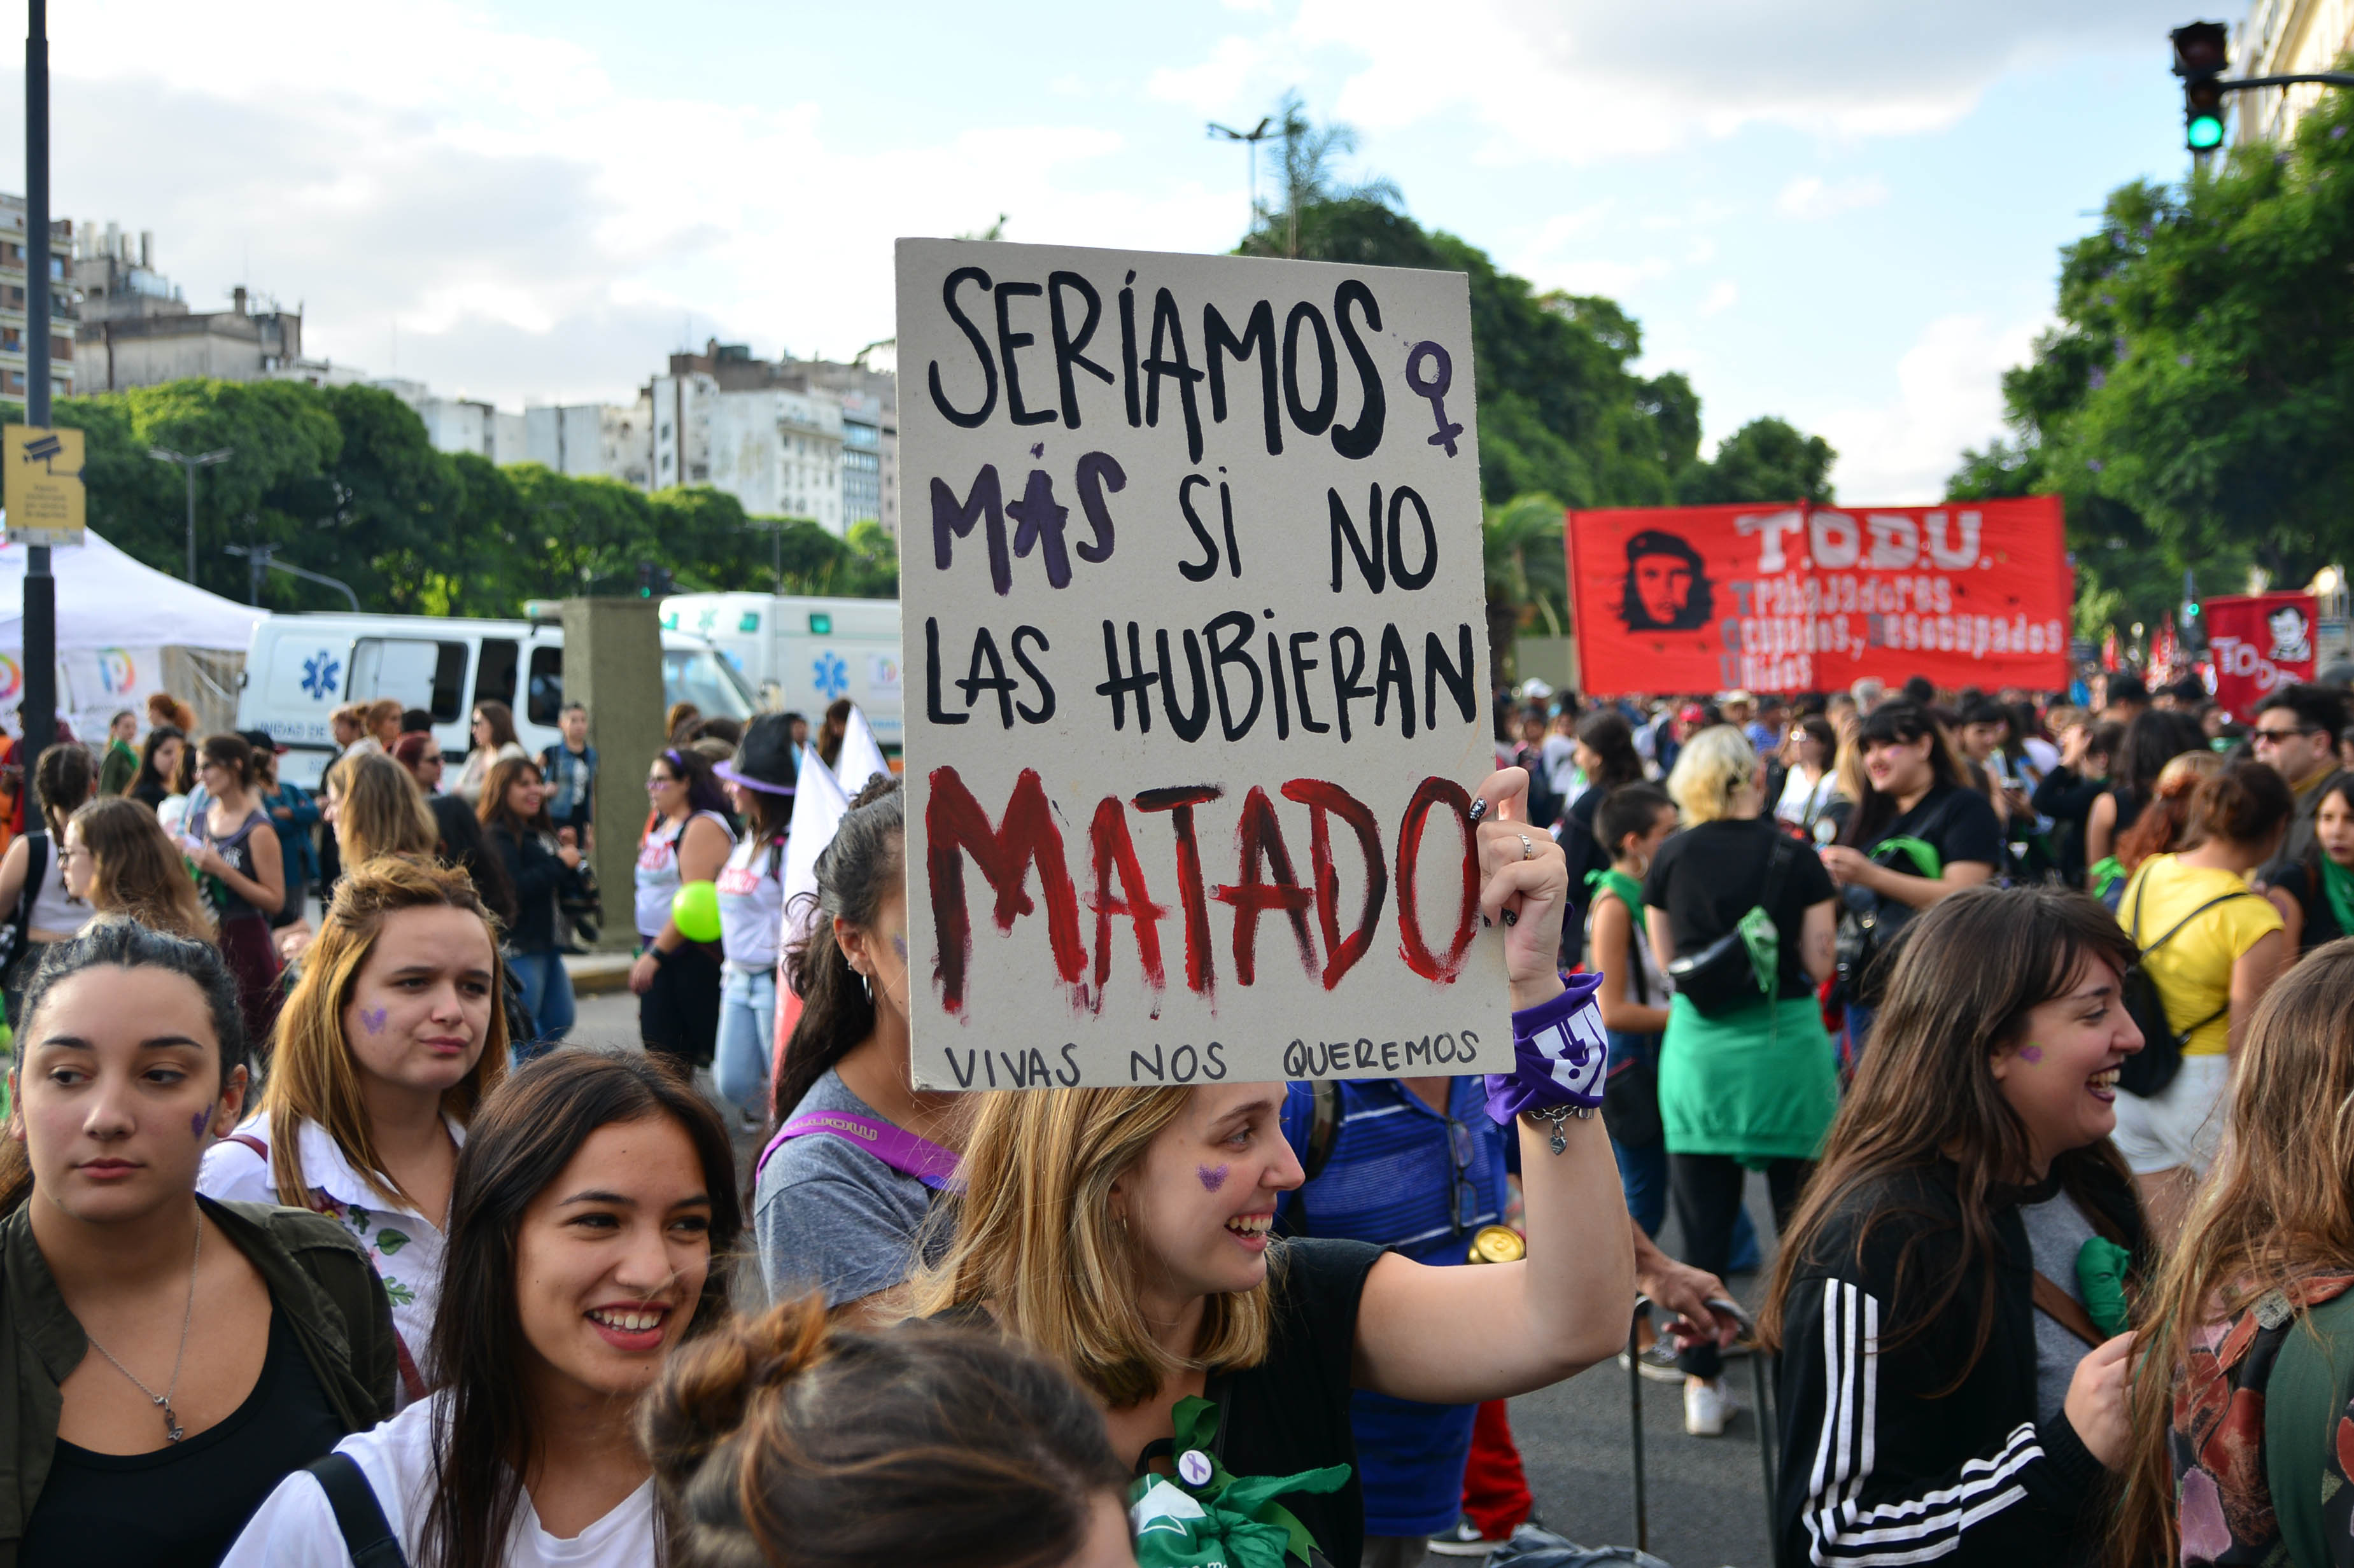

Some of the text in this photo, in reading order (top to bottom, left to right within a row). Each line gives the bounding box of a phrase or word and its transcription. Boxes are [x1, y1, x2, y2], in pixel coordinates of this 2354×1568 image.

[928, 265, 1387, 465] SERÍAMOS
[929, 441, 1439, 597] MÁS SI NO
[926, 608, 1477, 743] LAS HUBIERAN
[926, 766, 1481, 1020] MATADO
[945, 1030, 1480, 1088] VIVAS NOS QUEREMOS
